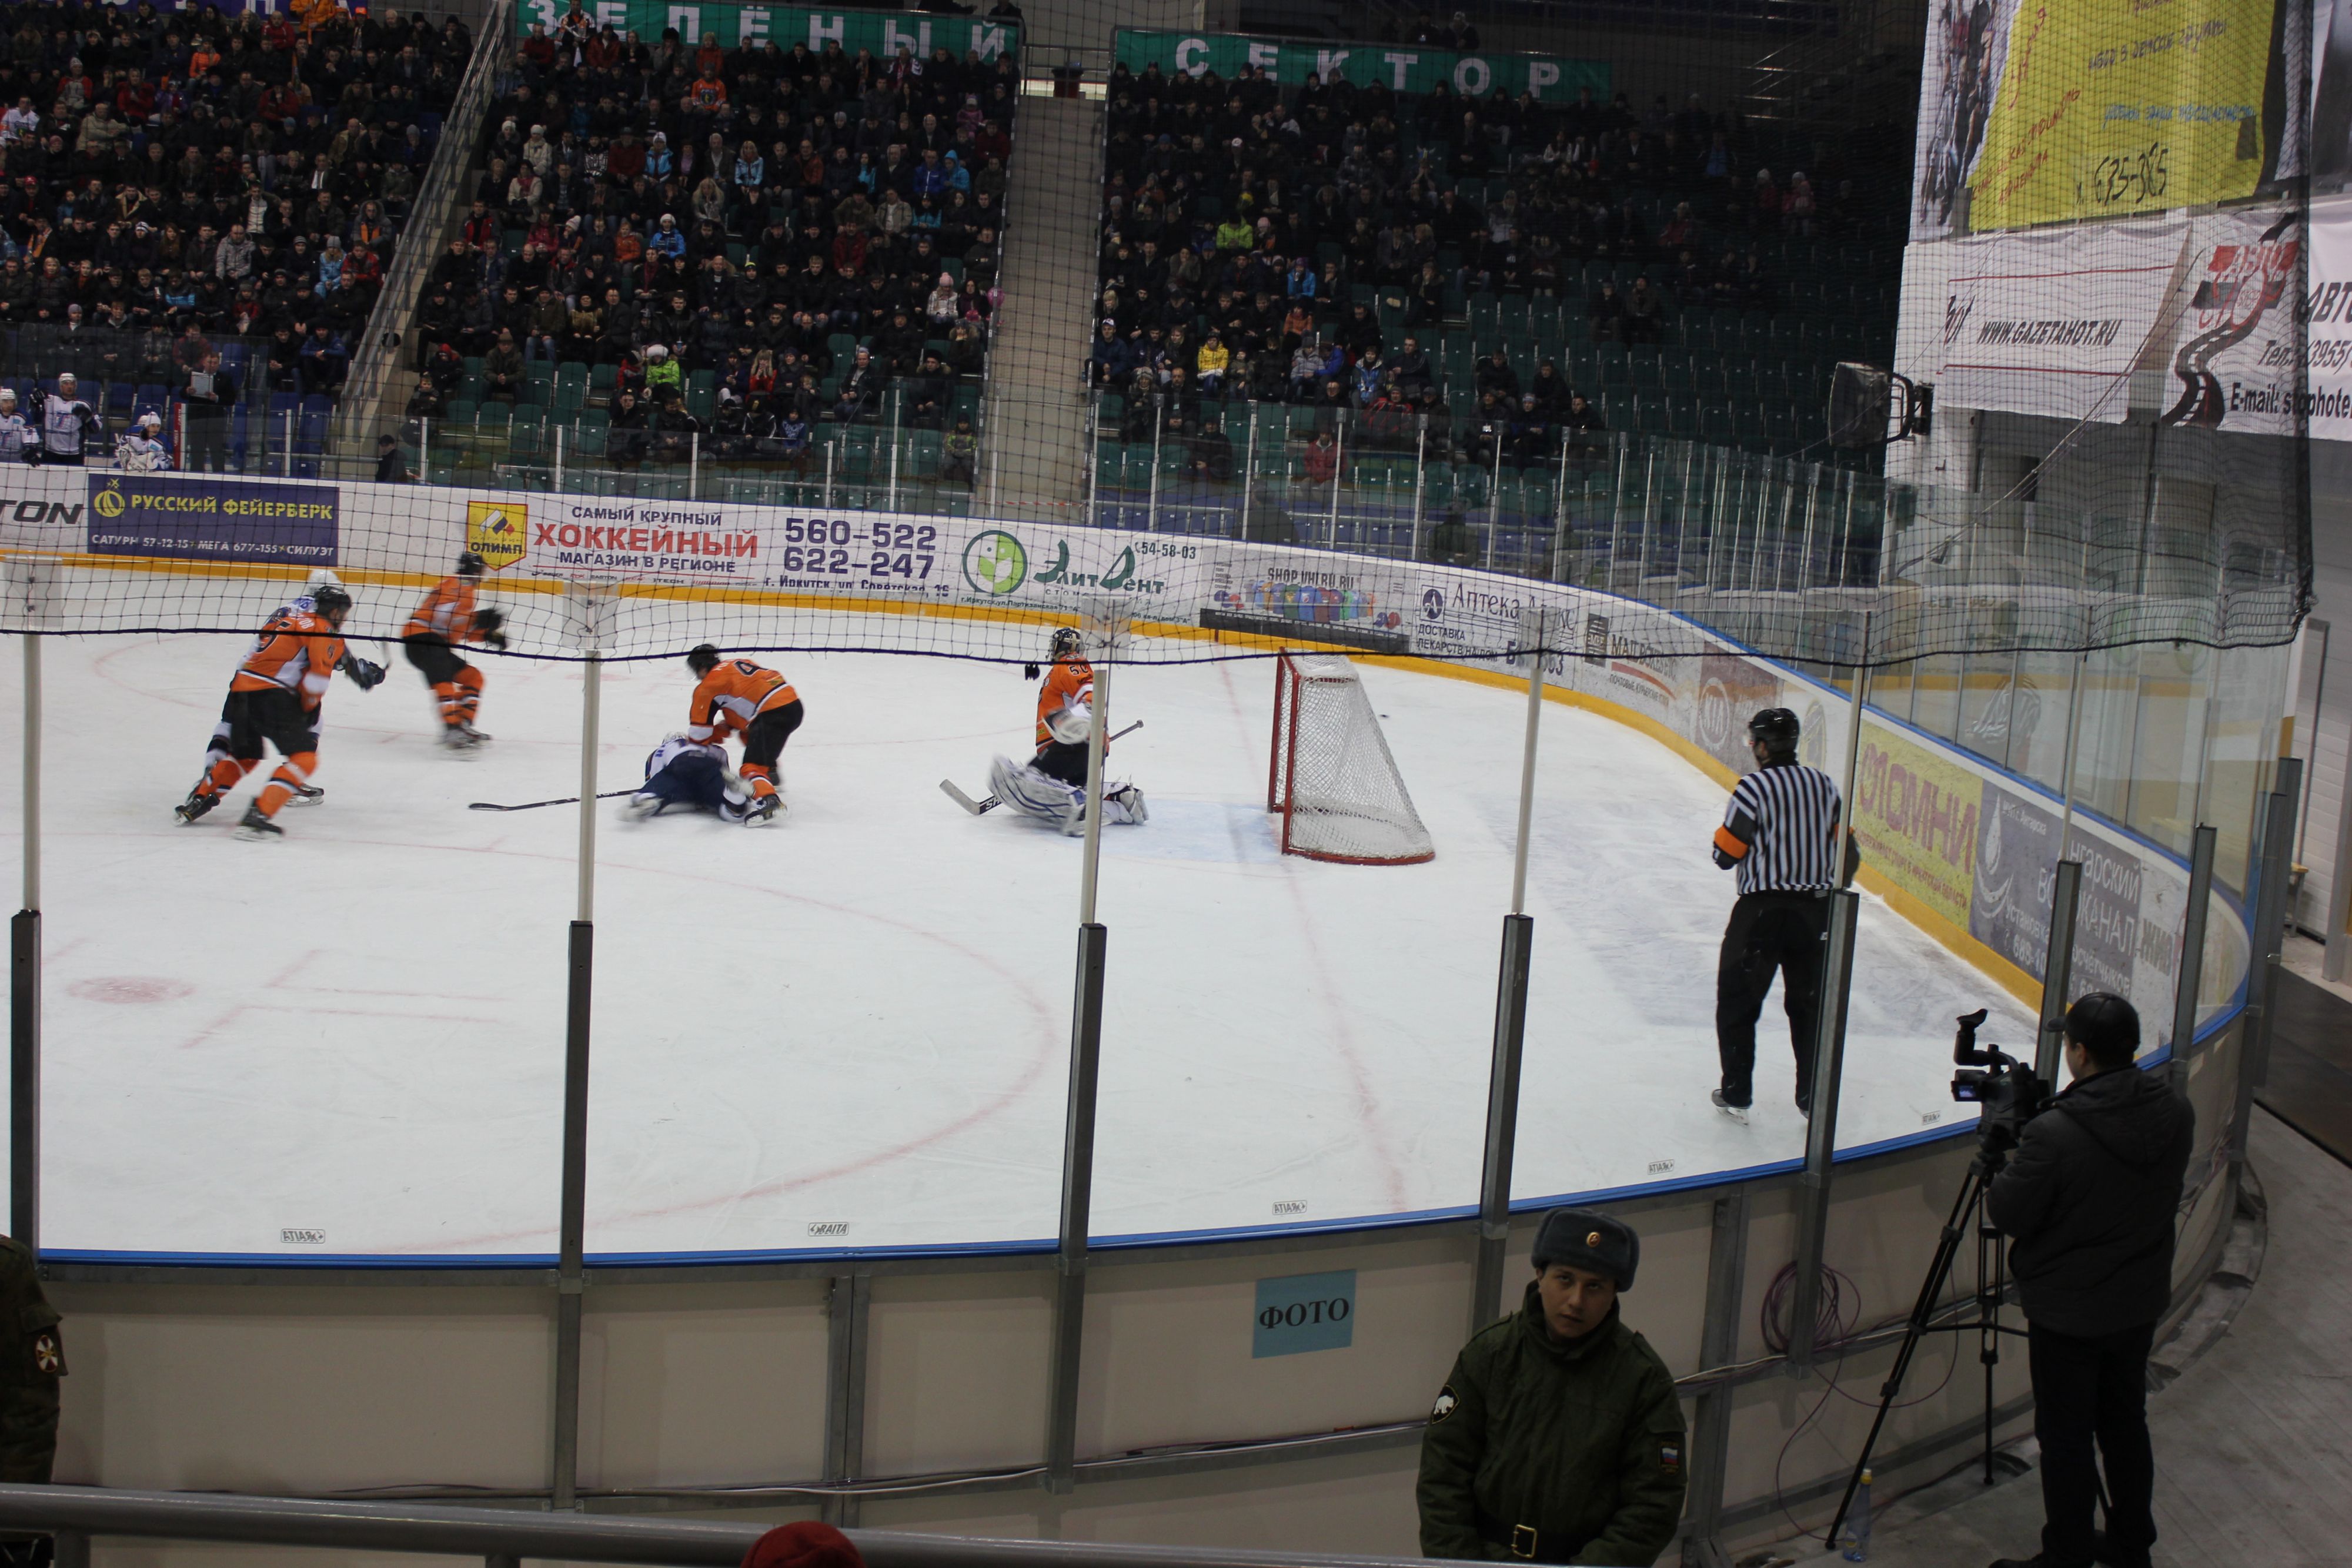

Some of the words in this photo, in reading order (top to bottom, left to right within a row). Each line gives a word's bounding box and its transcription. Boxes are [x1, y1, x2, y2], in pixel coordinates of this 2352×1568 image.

[132, 495, 216, 513] РУССКИЙ
[223, 499, 333, 520] ФЕЙЕРВЕРК
[572, 506, 634, 521] САМЫЙ
[640, 510, 721, 526] КРУПНЫЙ
[92, 534, 138, 545] САТУРН
[142, 537, 188, 548] 57-12-15
[198, 540, 229, 551] МЕГА
[233, 542, 277, 553] 677-155
[286, 546, 334, 556] СИЛУЭТ
[533, 523, 758, 558] ХОККЕЙНЫЙ
[785, 517, 936, 550] 560-522
[470, 541, 522, 554] ОЛИМП
[1141, 541, 1196, 559] 54-58-03
[560, 551, 638, 567] МАГАЗИН
[643, 556, 654, 568] В
[660, 557, 736, 573] РЕГИОНЕ
[784, 547, 934, 579] 622-247
[1452, 583, 1520, 620] Аптека
[1418, 624, 1465, 641] ДОСТАВКА
[1417, 638, 1463, 655] ЛЕКАРСТВ
[2058, 840, 2141, 904] нгарский
[1259, 1298, 1349, 1330] ФОТО
